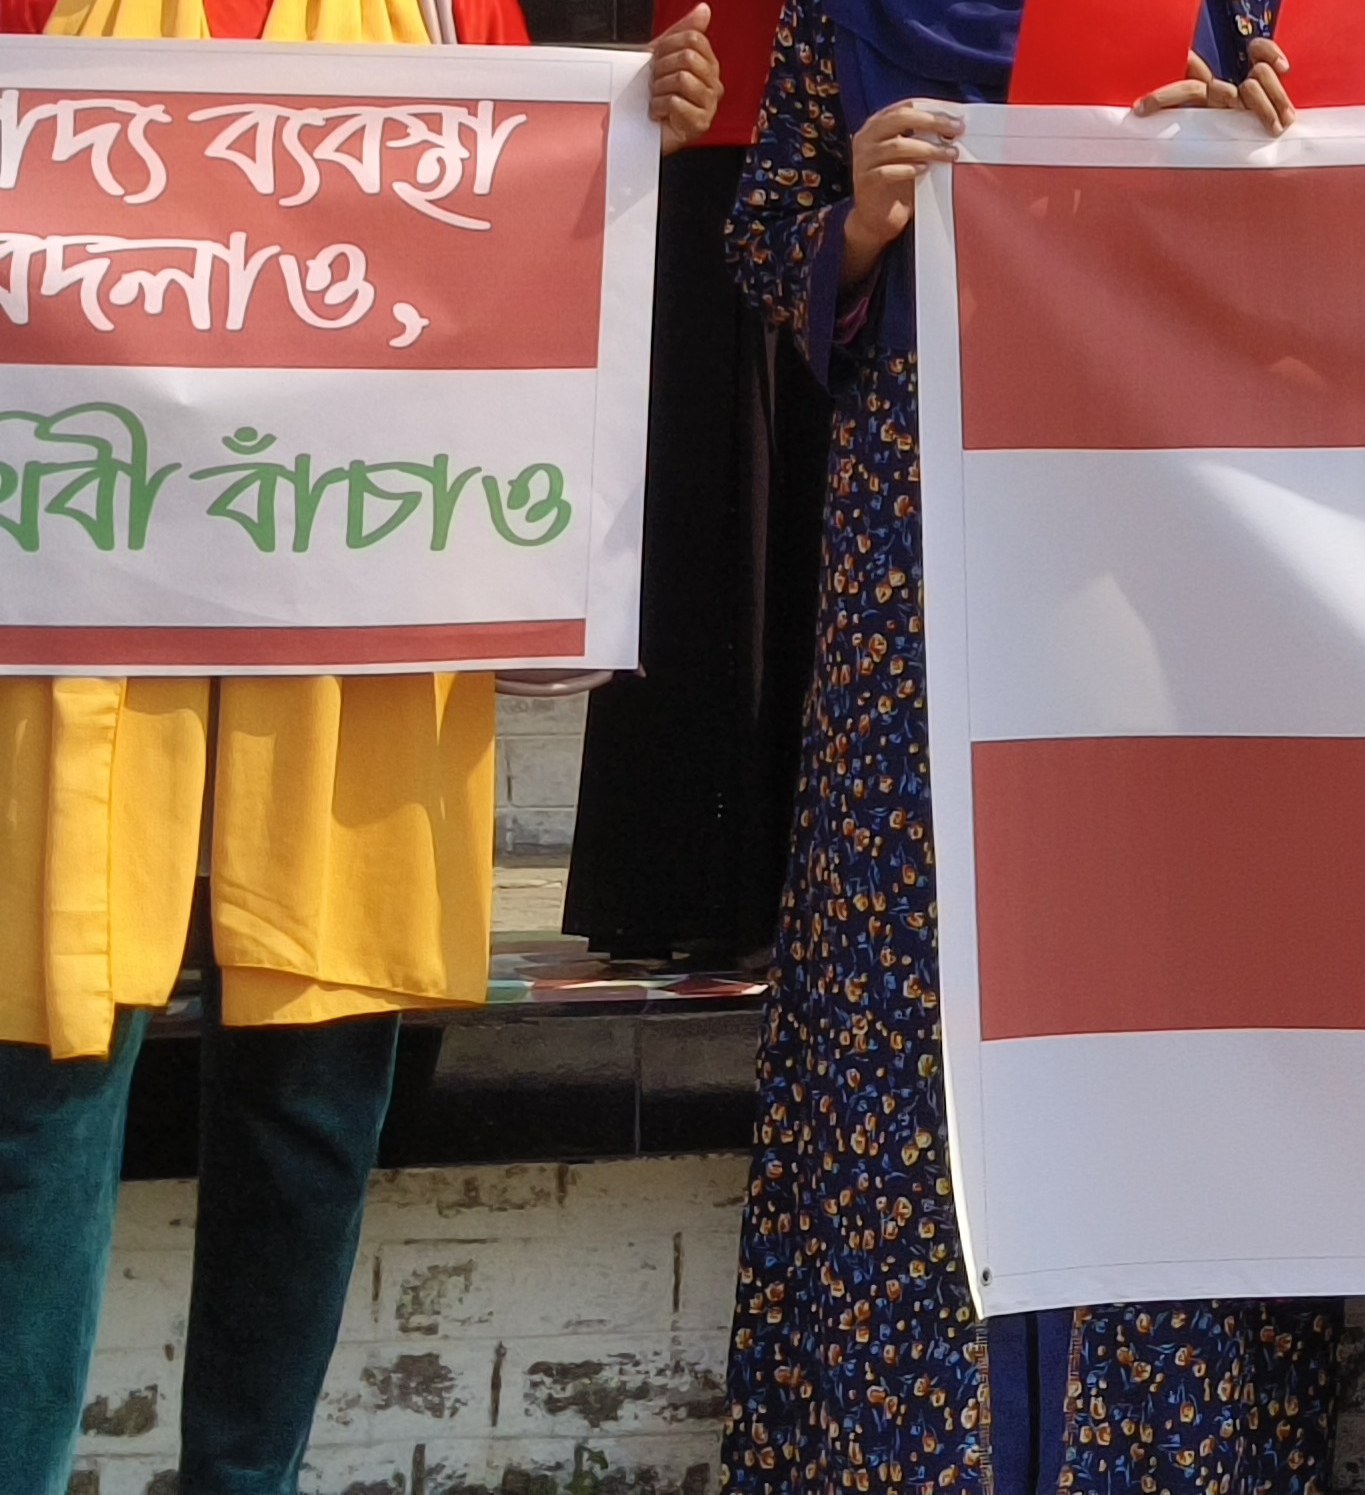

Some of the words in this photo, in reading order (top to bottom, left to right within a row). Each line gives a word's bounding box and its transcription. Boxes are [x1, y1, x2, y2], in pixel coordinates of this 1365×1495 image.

[0, 89, 172, 204] াদ্য
[187, 100, 527, 230] ব্যবস্থা
[188, 426, 572, 553] বাঁচাও
